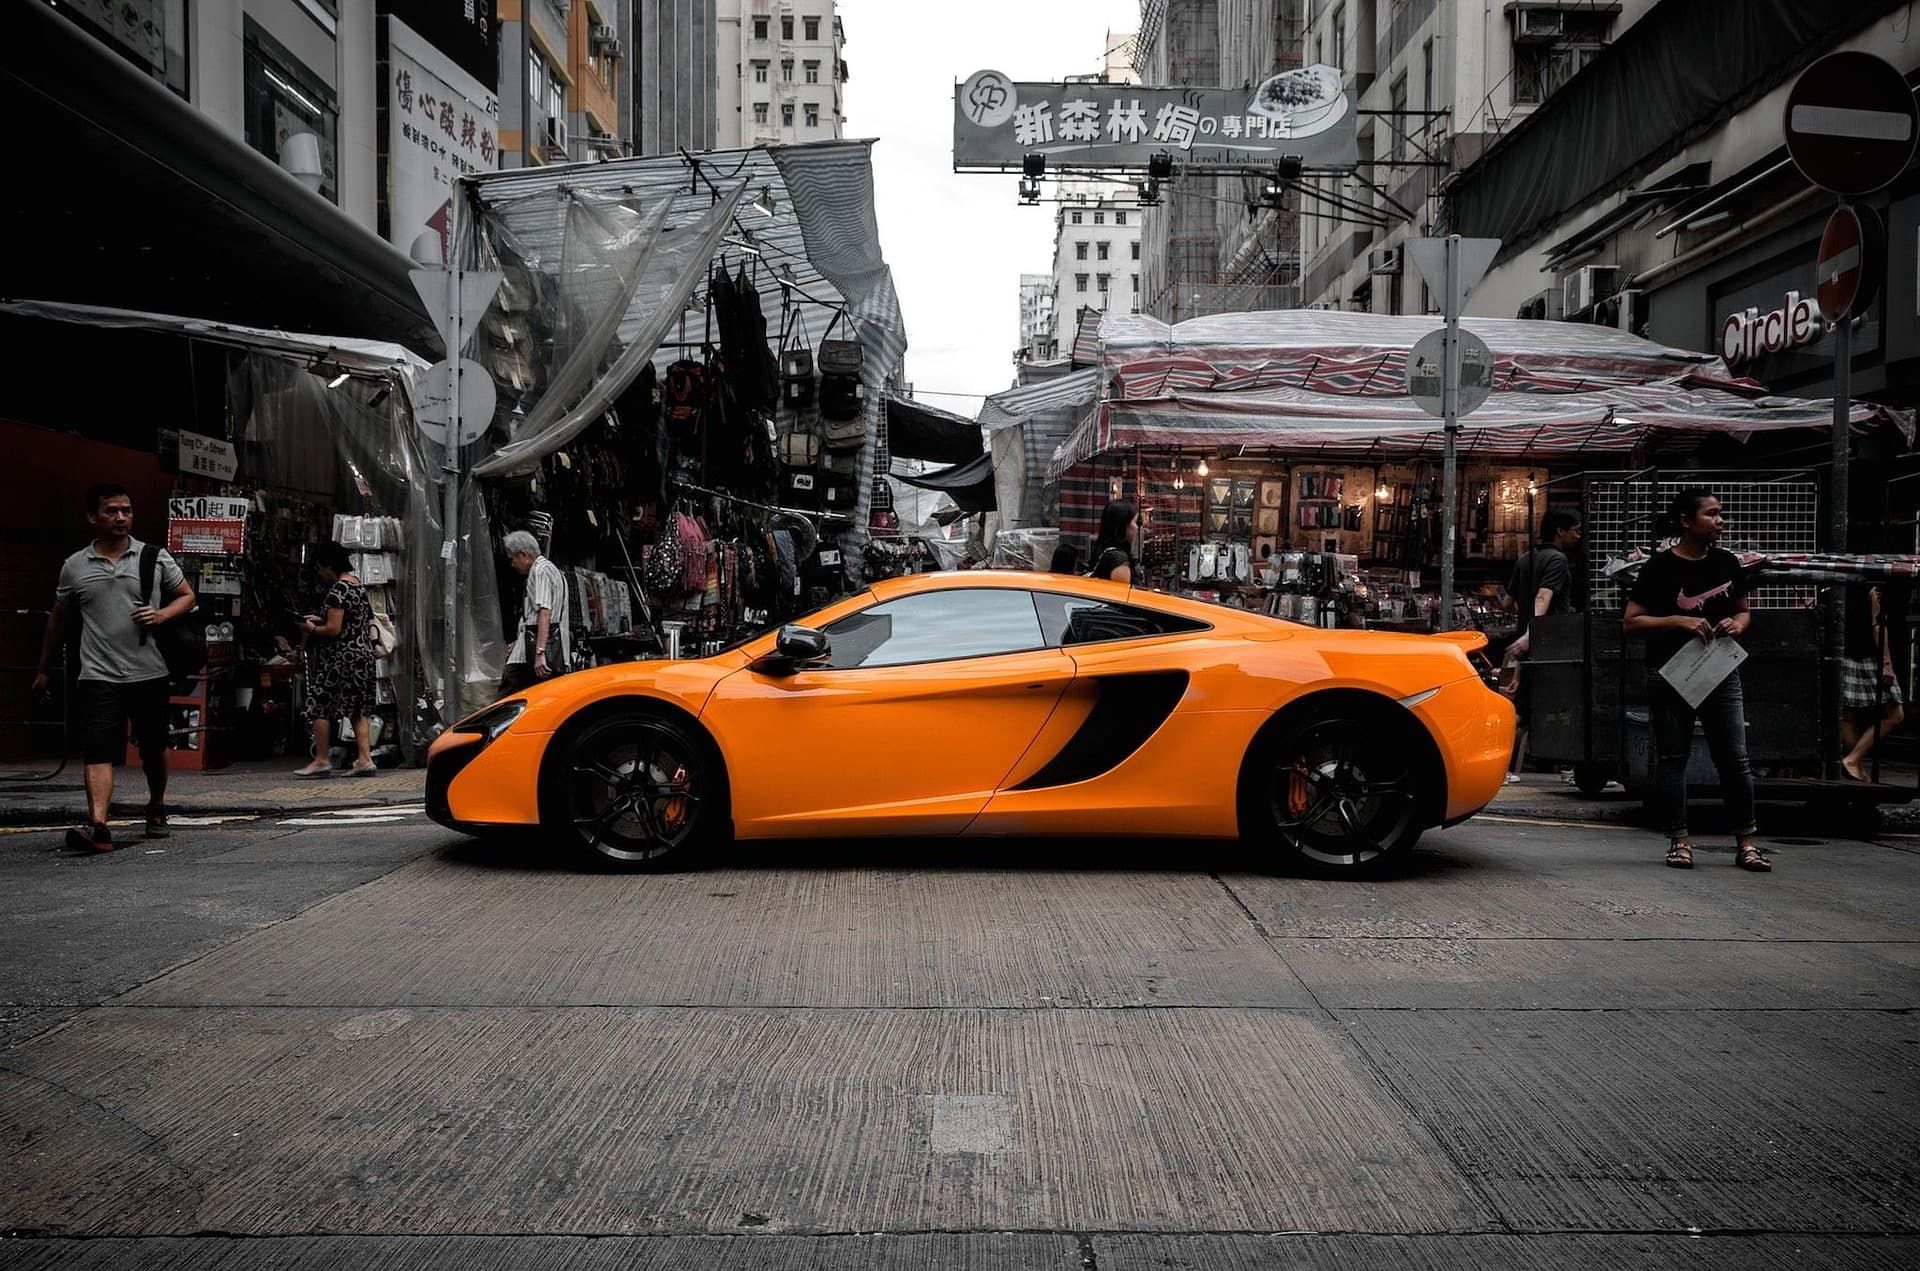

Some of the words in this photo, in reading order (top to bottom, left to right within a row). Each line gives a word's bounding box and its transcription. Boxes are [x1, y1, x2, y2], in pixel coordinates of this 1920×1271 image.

[396, 68, 495, 166] 傷心酸辣粉
[1721, 290, 1815, 366] Circle
[229, 503, 247, 519] up
